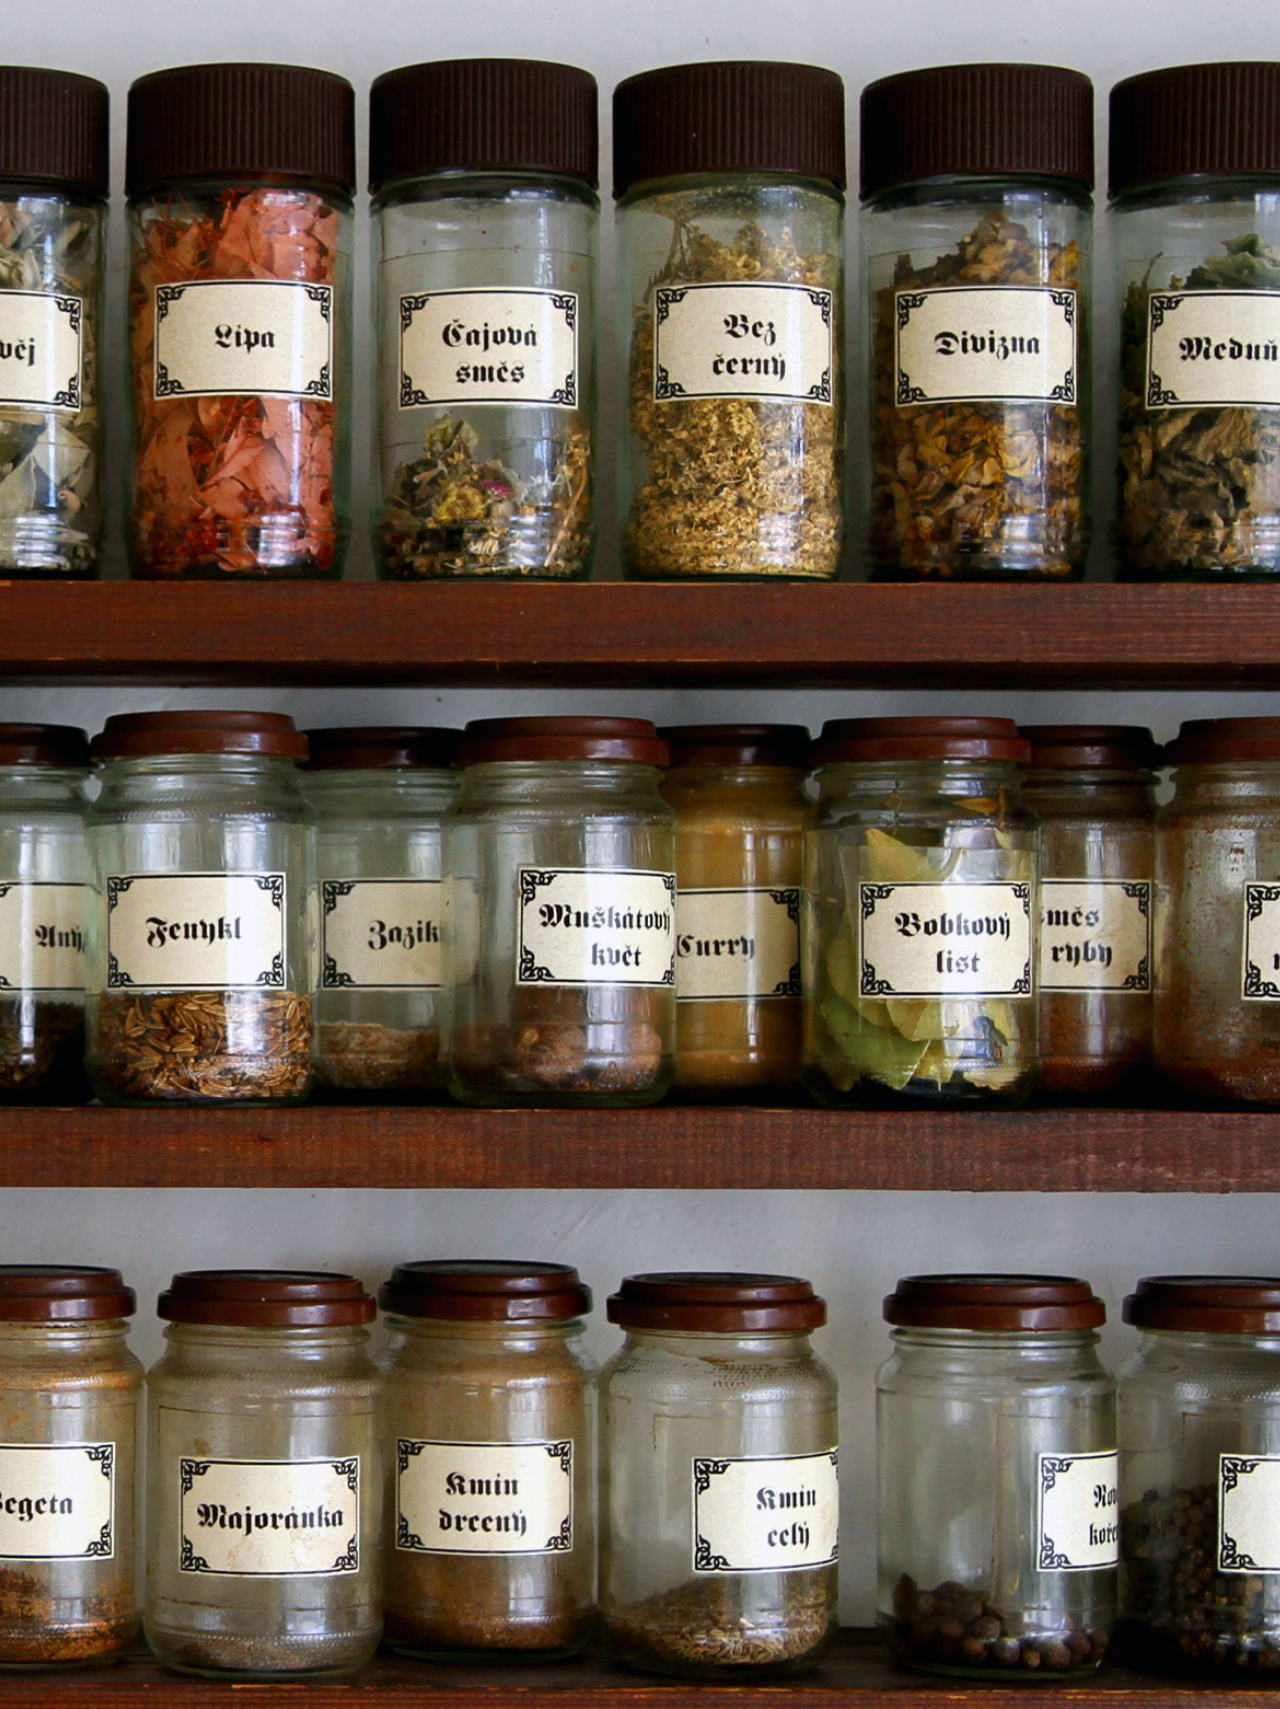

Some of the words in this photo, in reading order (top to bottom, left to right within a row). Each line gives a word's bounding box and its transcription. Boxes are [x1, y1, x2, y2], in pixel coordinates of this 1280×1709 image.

[442, 319, 536, 351] Čajová
[724, 314, 775, 345] Bez
[934, 330, 1039, 359] Divizna
[1179, 337, 1280, 361] Meduň
[456, 363, 524, 383] směs
[713, 354, 785, 380] černý
[539, 902, 672, 937] Muškátový
[895, 913, 1010, 940] Bobkový
[1039, 905, 1100, 928] měs
[35, 925, 86, 953] Aný
[146, 917, 240, 947] Fenykl
[368, 919, 442, 950] Zazik
[592, 944, 641, 966] květ
[937, 951, 979, 973] list
[1052, 941, 1112, 968] ryby
[197, 1503, 343, 1536] Majoránka
[439, 1509, 526, 1535] drcený
[768, 1522, 809, 1548] celý
